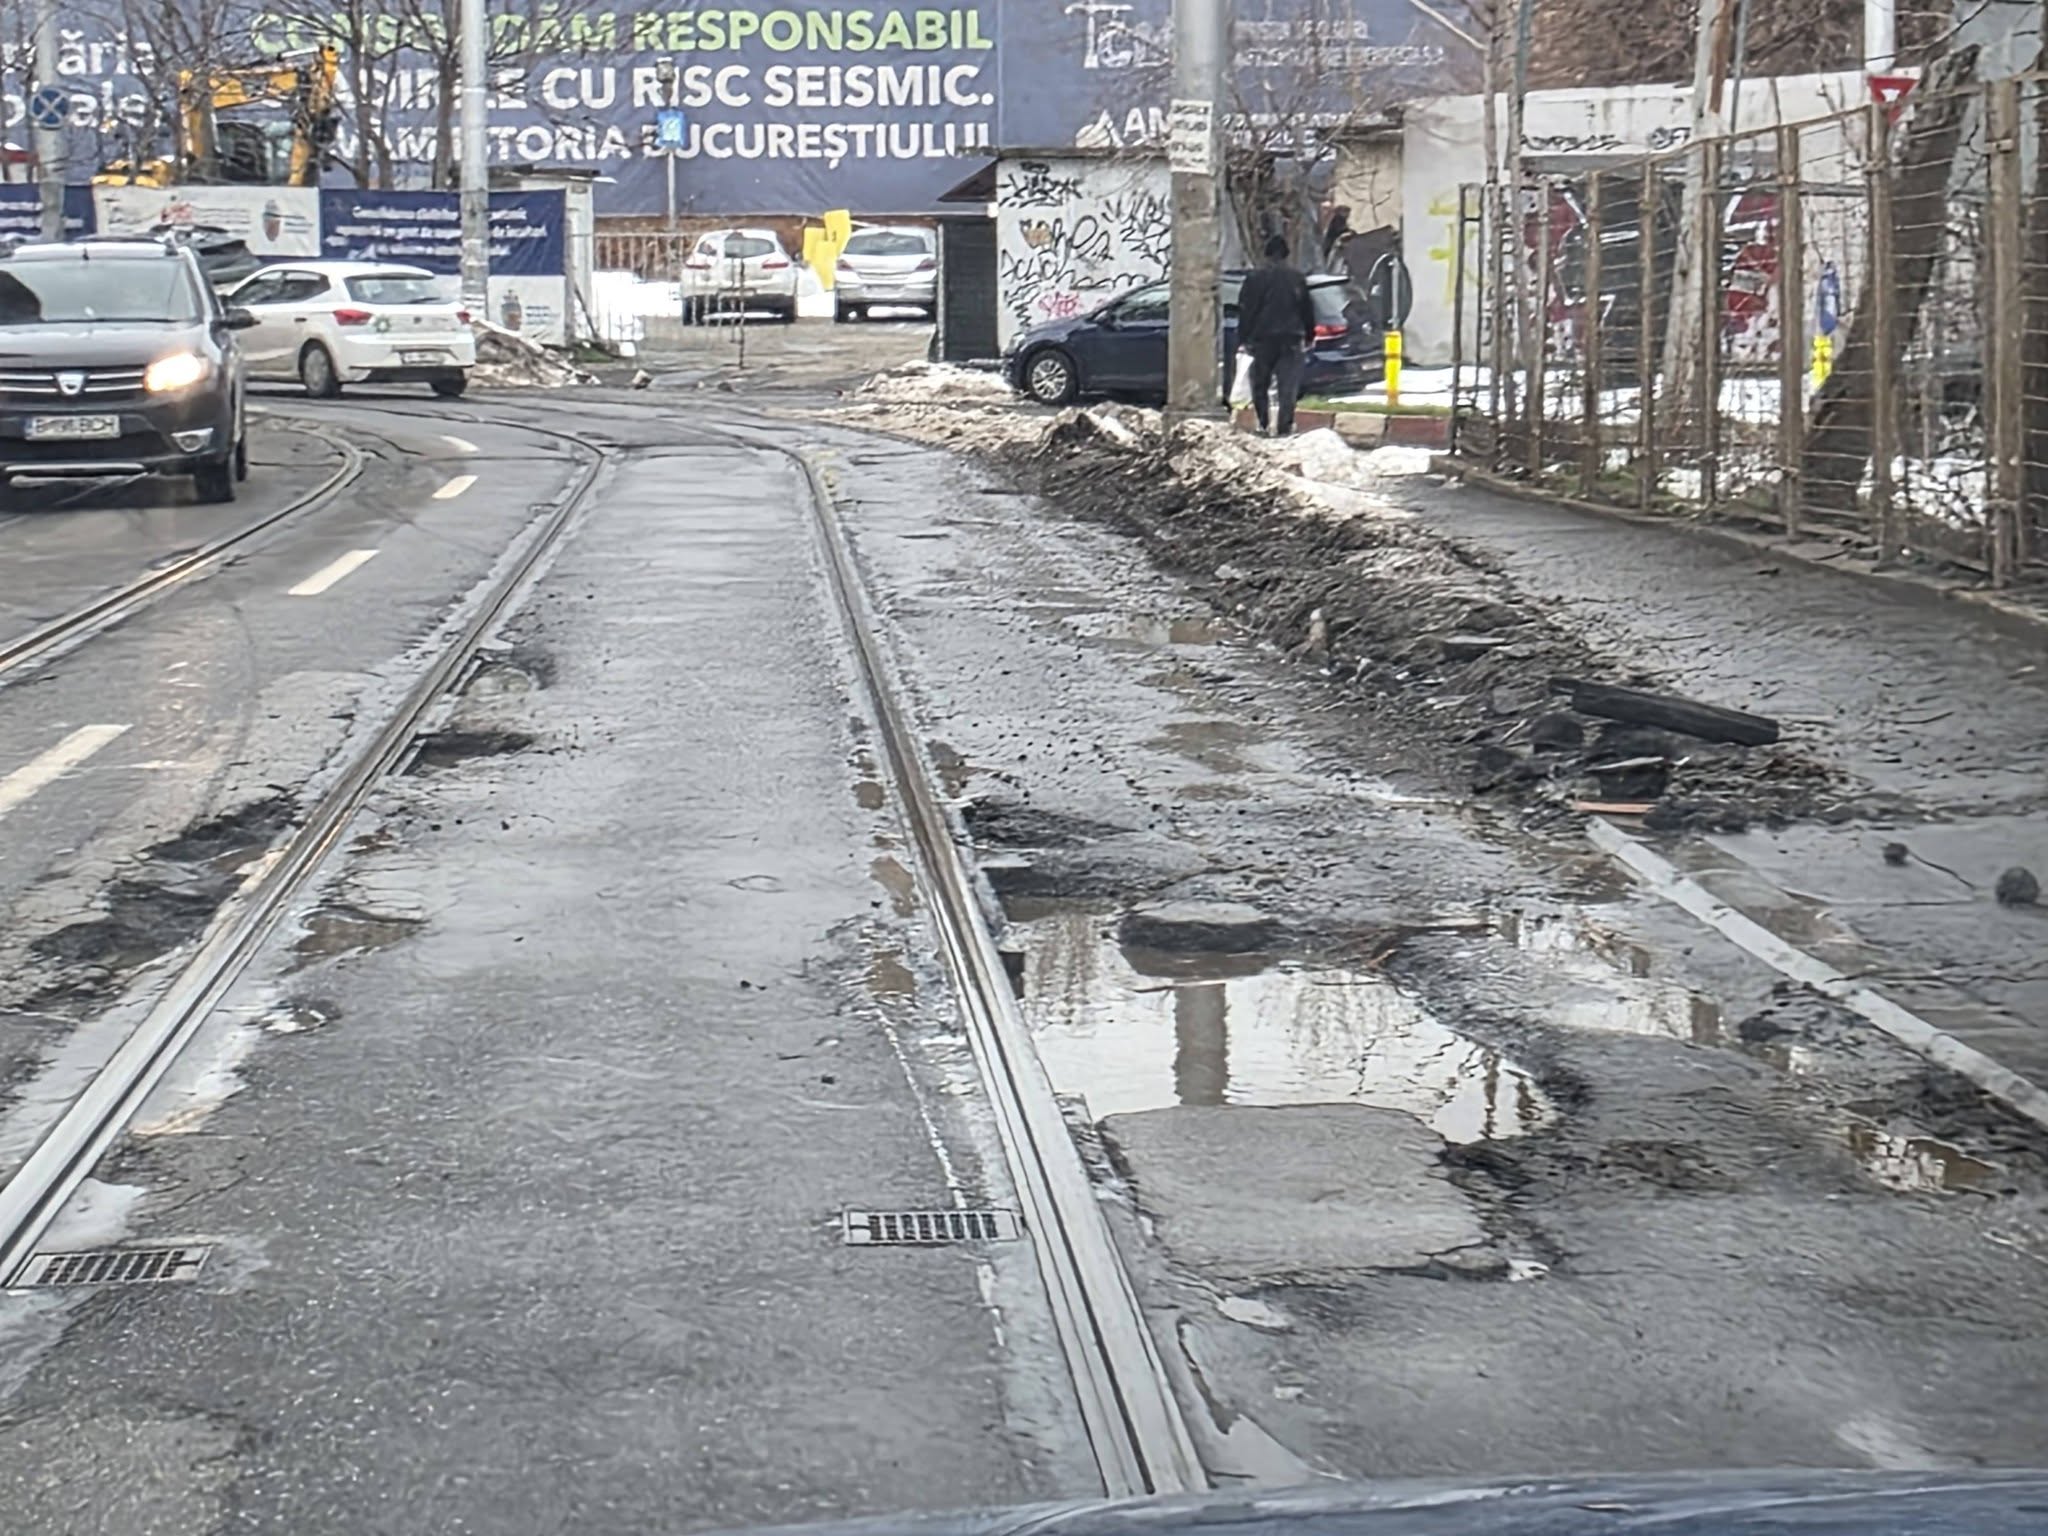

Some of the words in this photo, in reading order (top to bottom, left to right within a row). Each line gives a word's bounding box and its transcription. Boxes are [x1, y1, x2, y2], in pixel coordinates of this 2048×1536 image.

[250, 2, 617, 55] CONSODĂM
[633, 9, 994, 52] RESPONSABIL
[542, 67, 616, 109] CU
[633, 65, 752, 108] RISC
[763, 64, 994, 107] SEISMIC.
[451, 124, 632, 161] ITORIA
[641, 122, 990, 170] BUCUREȘTIULUI
